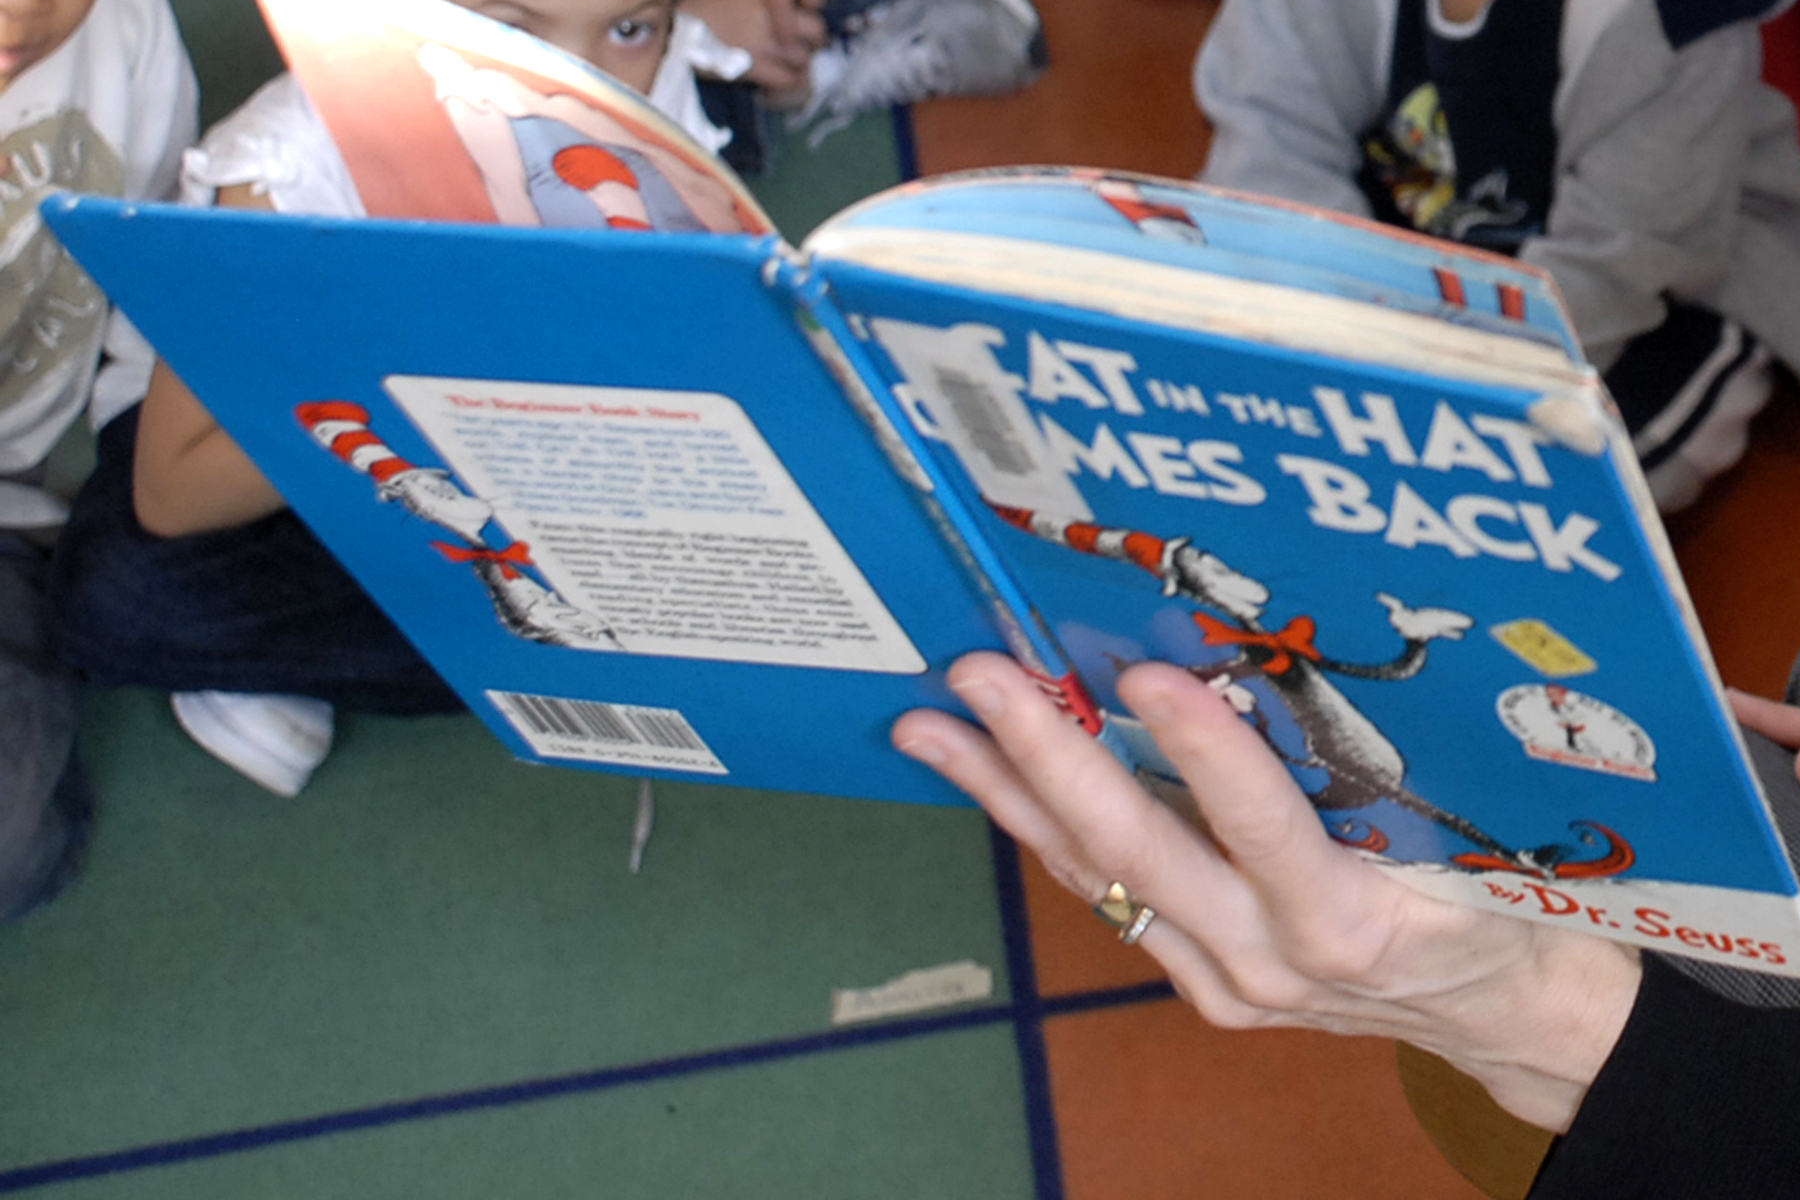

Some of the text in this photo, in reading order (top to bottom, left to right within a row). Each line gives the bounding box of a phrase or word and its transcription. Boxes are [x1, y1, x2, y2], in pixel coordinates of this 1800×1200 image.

[1146, 378, 1211, 417] IN
[1216, 391, 1323, 438] THE
[1311, 385, 1553, 488] HAT
[1275, 453, 1623, 583] BACK
[1522, 881, 1622, 929] Dr.
[1633, 907, 1787, 965] Seuss
